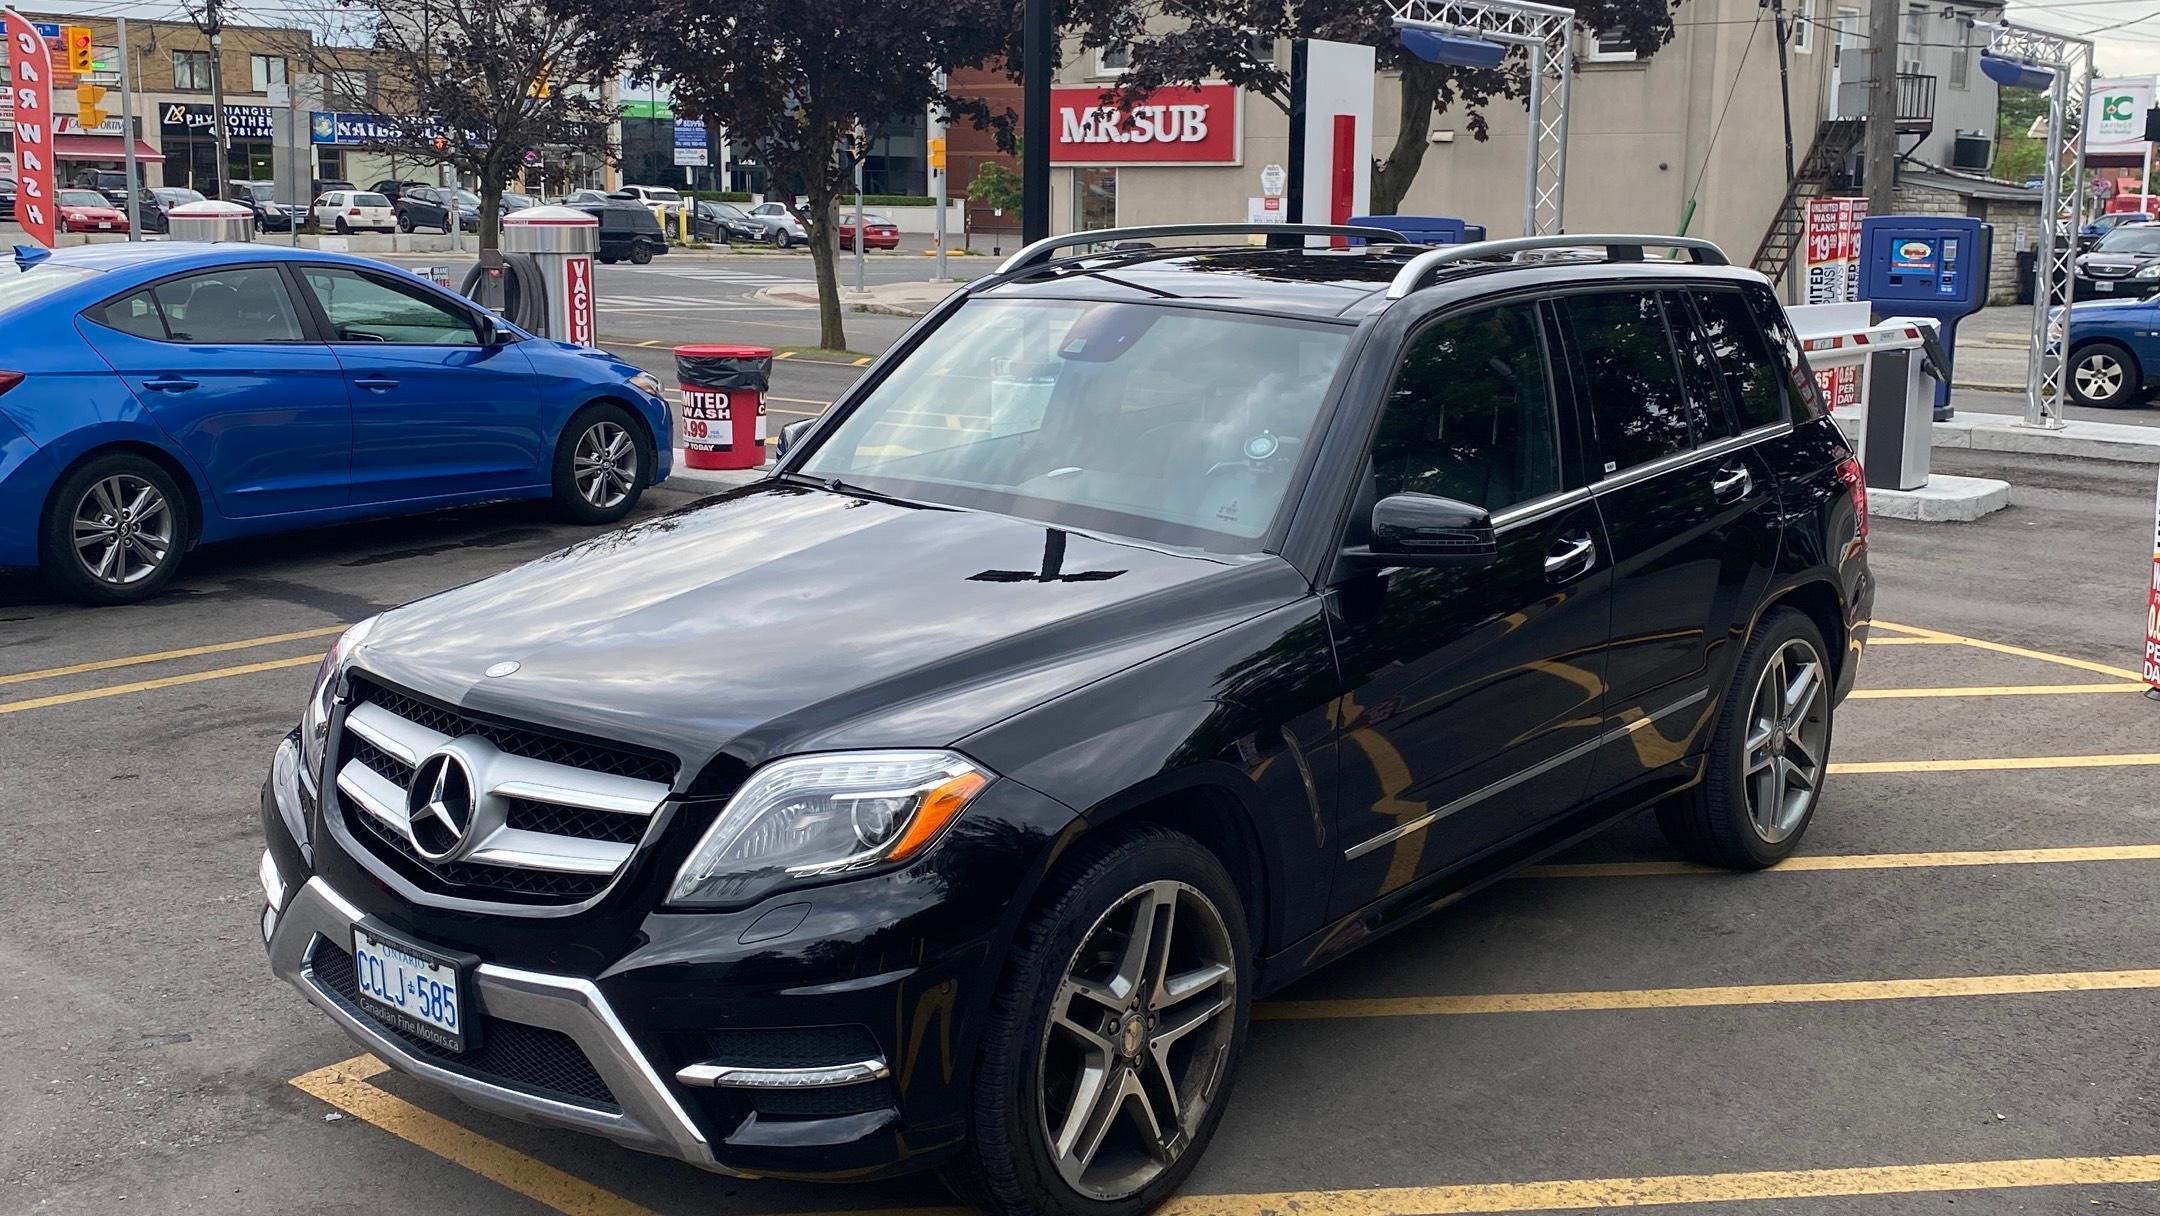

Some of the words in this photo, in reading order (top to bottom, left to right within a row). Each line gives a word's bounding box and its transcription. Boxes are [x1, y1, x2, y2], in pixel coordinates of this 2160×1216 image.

[223, 106, 272, 116] RIANGLE
[1813, 213, 1836, 222] WASH
[572, 261, 590, 347] VACUU
[1839, 384, 1855, 394] PER
[1838, 395, 1855, 405] DAY
[382, 945, 425, 970] ONTARIO
[416, 974, 456, 1028] 585
[360, 997, 397, 1024] Canadian
[397, 1014, 416, 1032] Fine
[416, 1023, 460, 1051] Motors.ca
